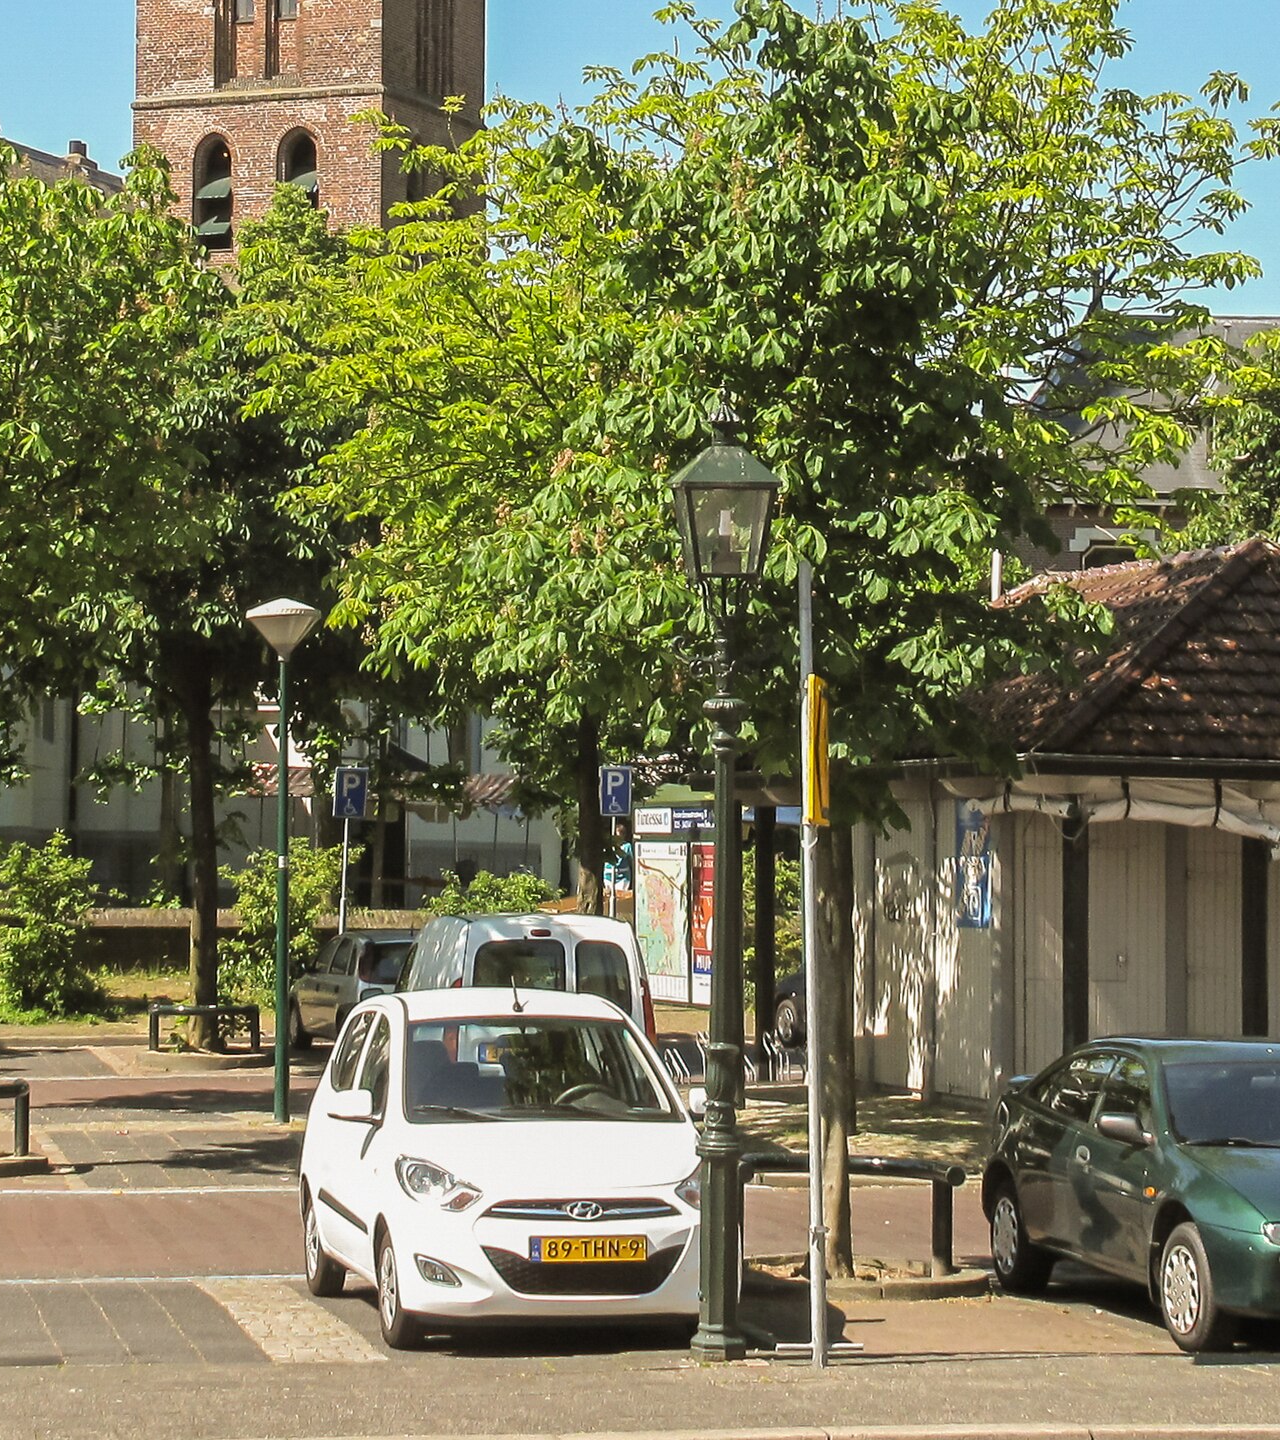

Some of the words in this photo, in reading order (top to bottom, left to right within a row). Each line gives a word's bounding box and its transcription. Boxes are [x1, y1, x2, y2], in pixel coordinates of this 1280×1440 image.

[343, 772, 360, 797] P
[607, 771, 624, 795] P
[547, 1240, 641, 1258] 89-THN-9
